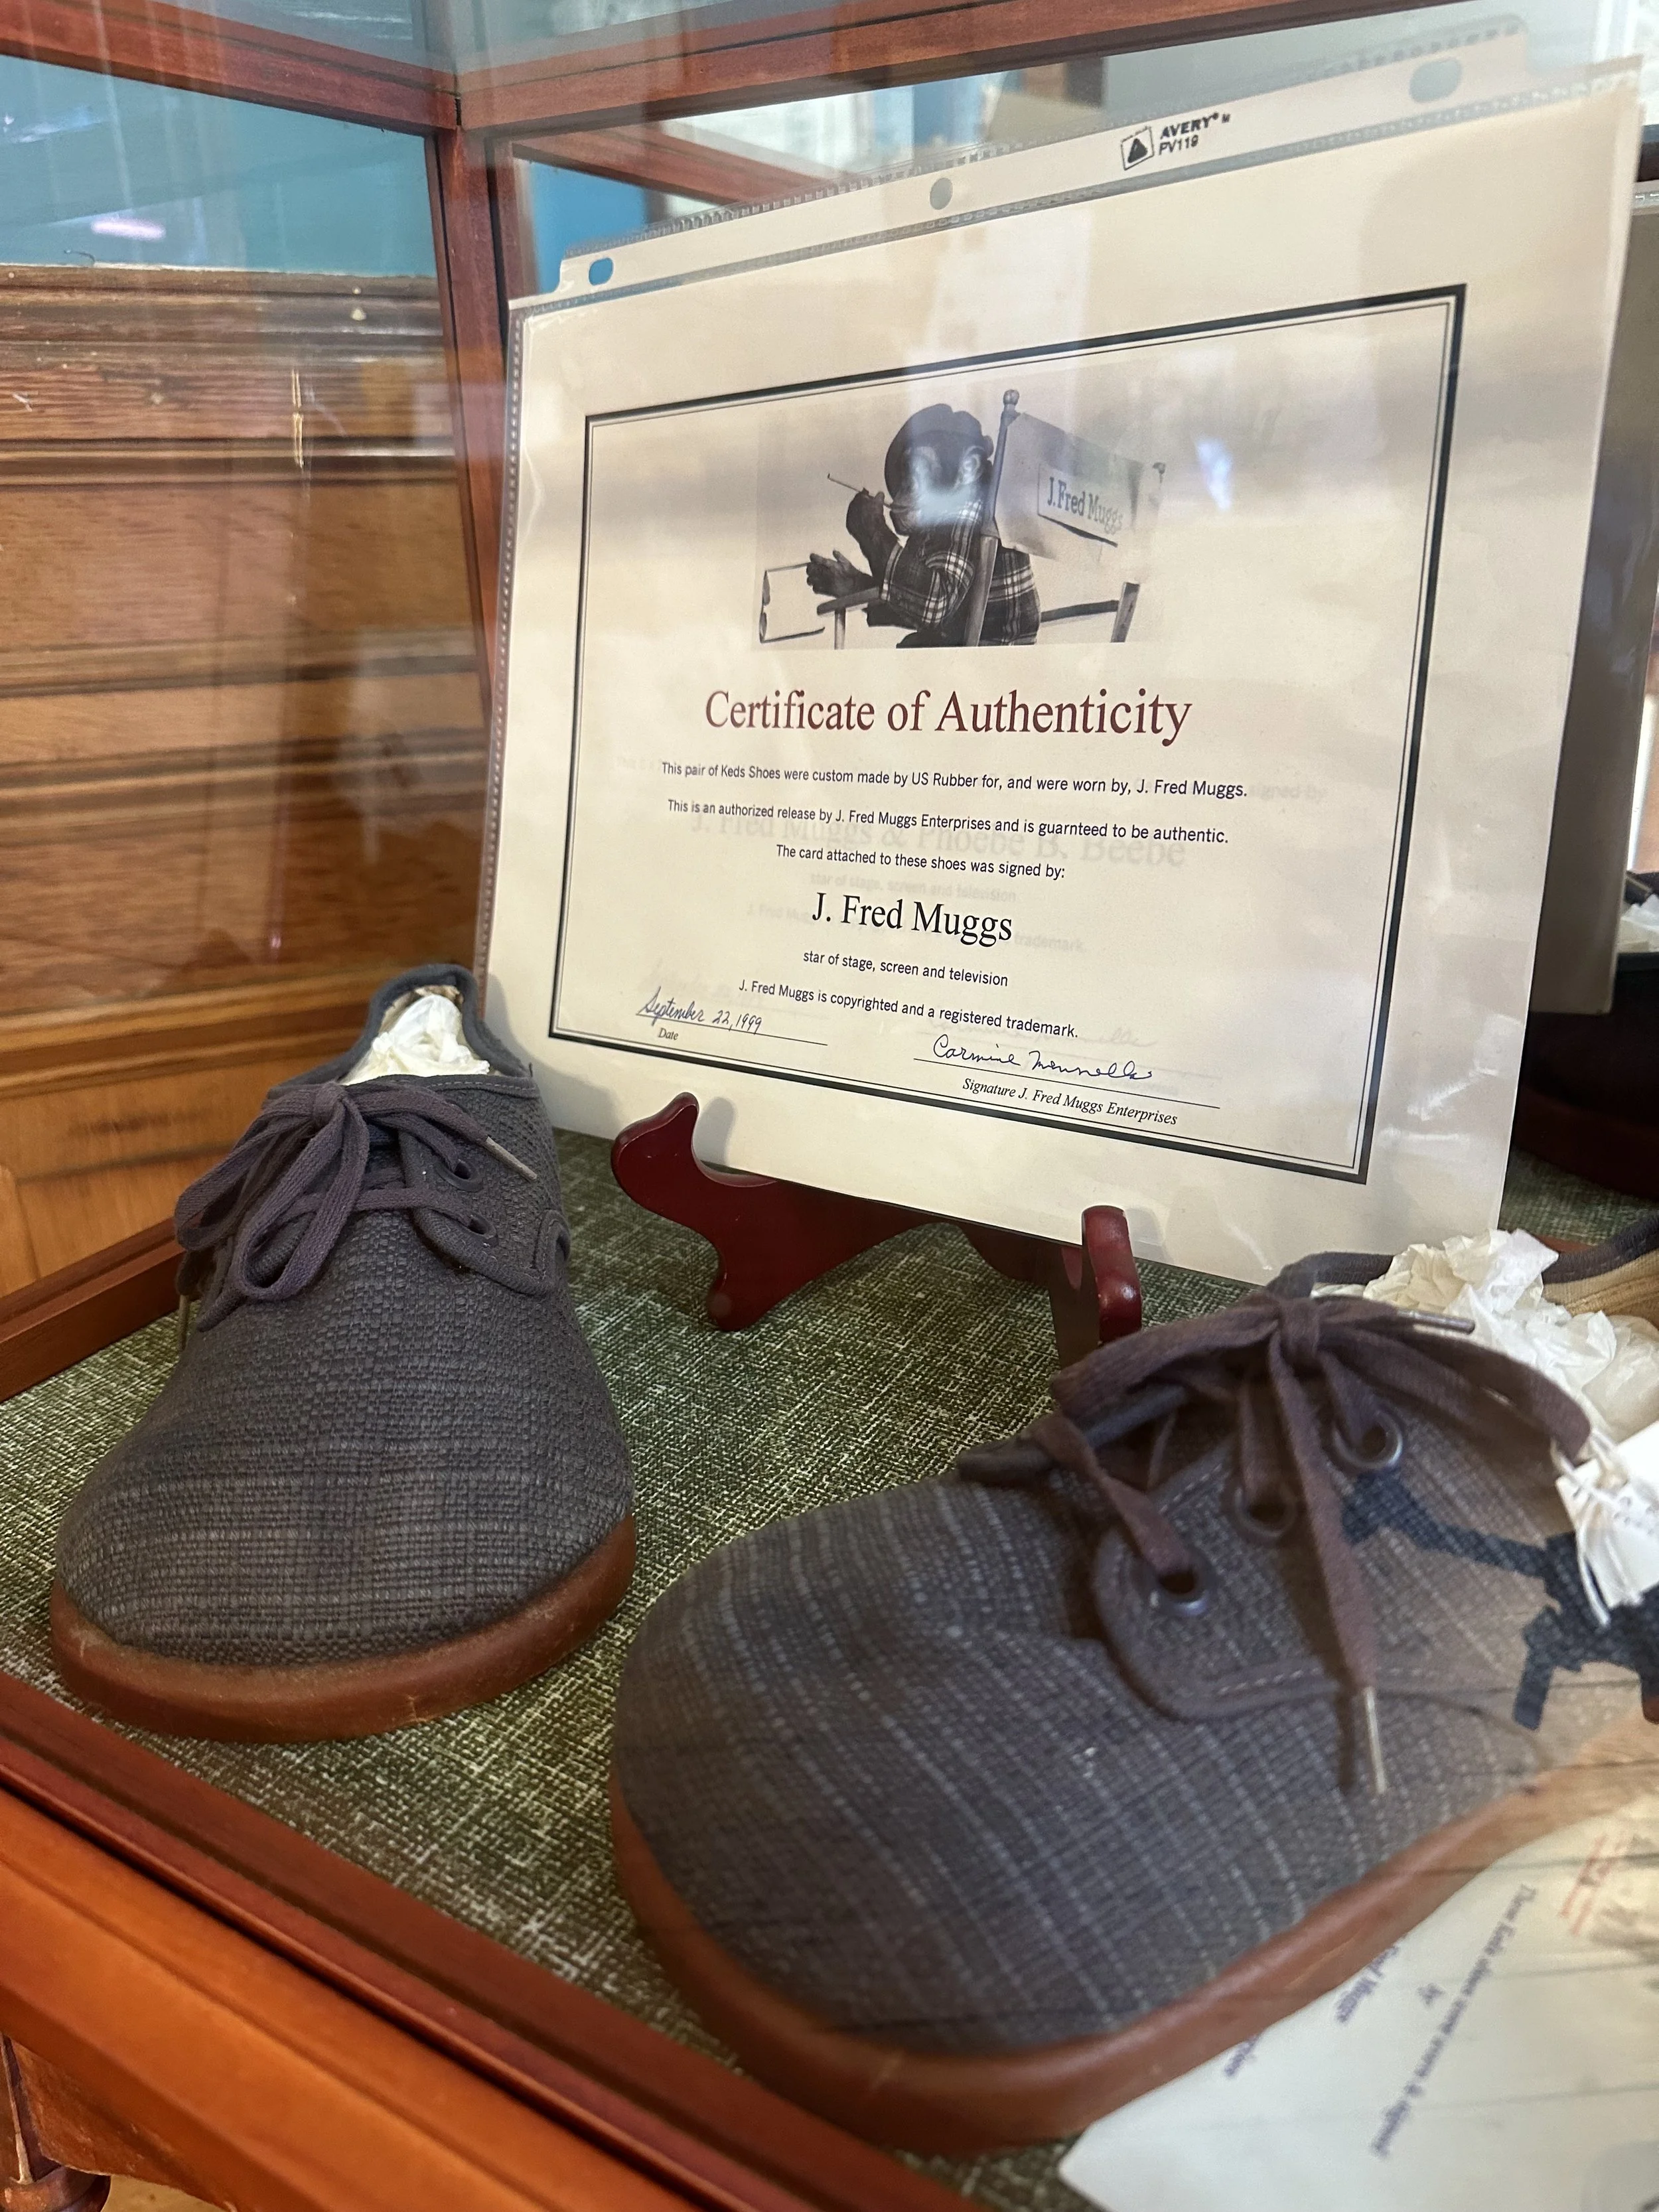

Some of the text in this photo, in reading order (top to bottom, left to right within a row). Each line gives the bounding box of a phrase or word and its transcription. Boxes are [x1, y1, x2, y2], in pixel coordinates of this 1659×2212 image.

[1159, 135, 1199, 155] PV119
[1088, 493, 1124, 536] Muggs
[705, 688, 1193, 747] Certificate of Authenticity
[662, 761, 682, 775] This
[685, 764, 705, 778] pair
[708, 765, 719, 776] of
[721, 764, 745, 778] Keds
[748, 765, 781, 780] Shoes
[784, 769, 809, 782] were
[812, 769, 853, 783] custom
[857, 771, 890, 784] made
[893, 771, 908, 788] by
[911, 772, 929, 786] US
[932, 773, 979, 788] Rubber
[981, 774, 1003, 790] for,
[1007, 775, 1032, 790] and
[1037, 778, 1069, 792] were
[1072, 779, 1106, 792] worn
[1111, 777, 1132, 795] by,
[1135, 778, 1149, 794] J.
[1154, 778, 1188, 796] Fred
[1192, 780, 1248, 800] Muggs.
[668, 798, 1230, 845] This is an authorized release by J. Fred Muggs Enterprises and is guarnteed to be authentic.
[776, 844, 1066, 881] The card attached to these shoes was signed by:
[812, 892, 1013, 948] J. Fred Muggs
[803, 950, 1009, 988] star of stage, screen and television
[636, 986, 705, 1027] September
[739, 979, 748, 992] J.
[751, 980, 776, 996] Fred
[778, 984, 815, 1003] Muggs
[818, 989, 828, 1003] is
[830, 992, 899, 1015] copyrighted
[901, 1003, 925, 1017] and
[928, 1007, 936, 1019] a
[938, 1008, 1003, 1029] registered
[1006, 1015, 1080, 1039] trademark.
[658, 1027, 680, 1041] Date
[962, 1077, 1179, 1126] Signature J. Fred Muggs Enterprises
